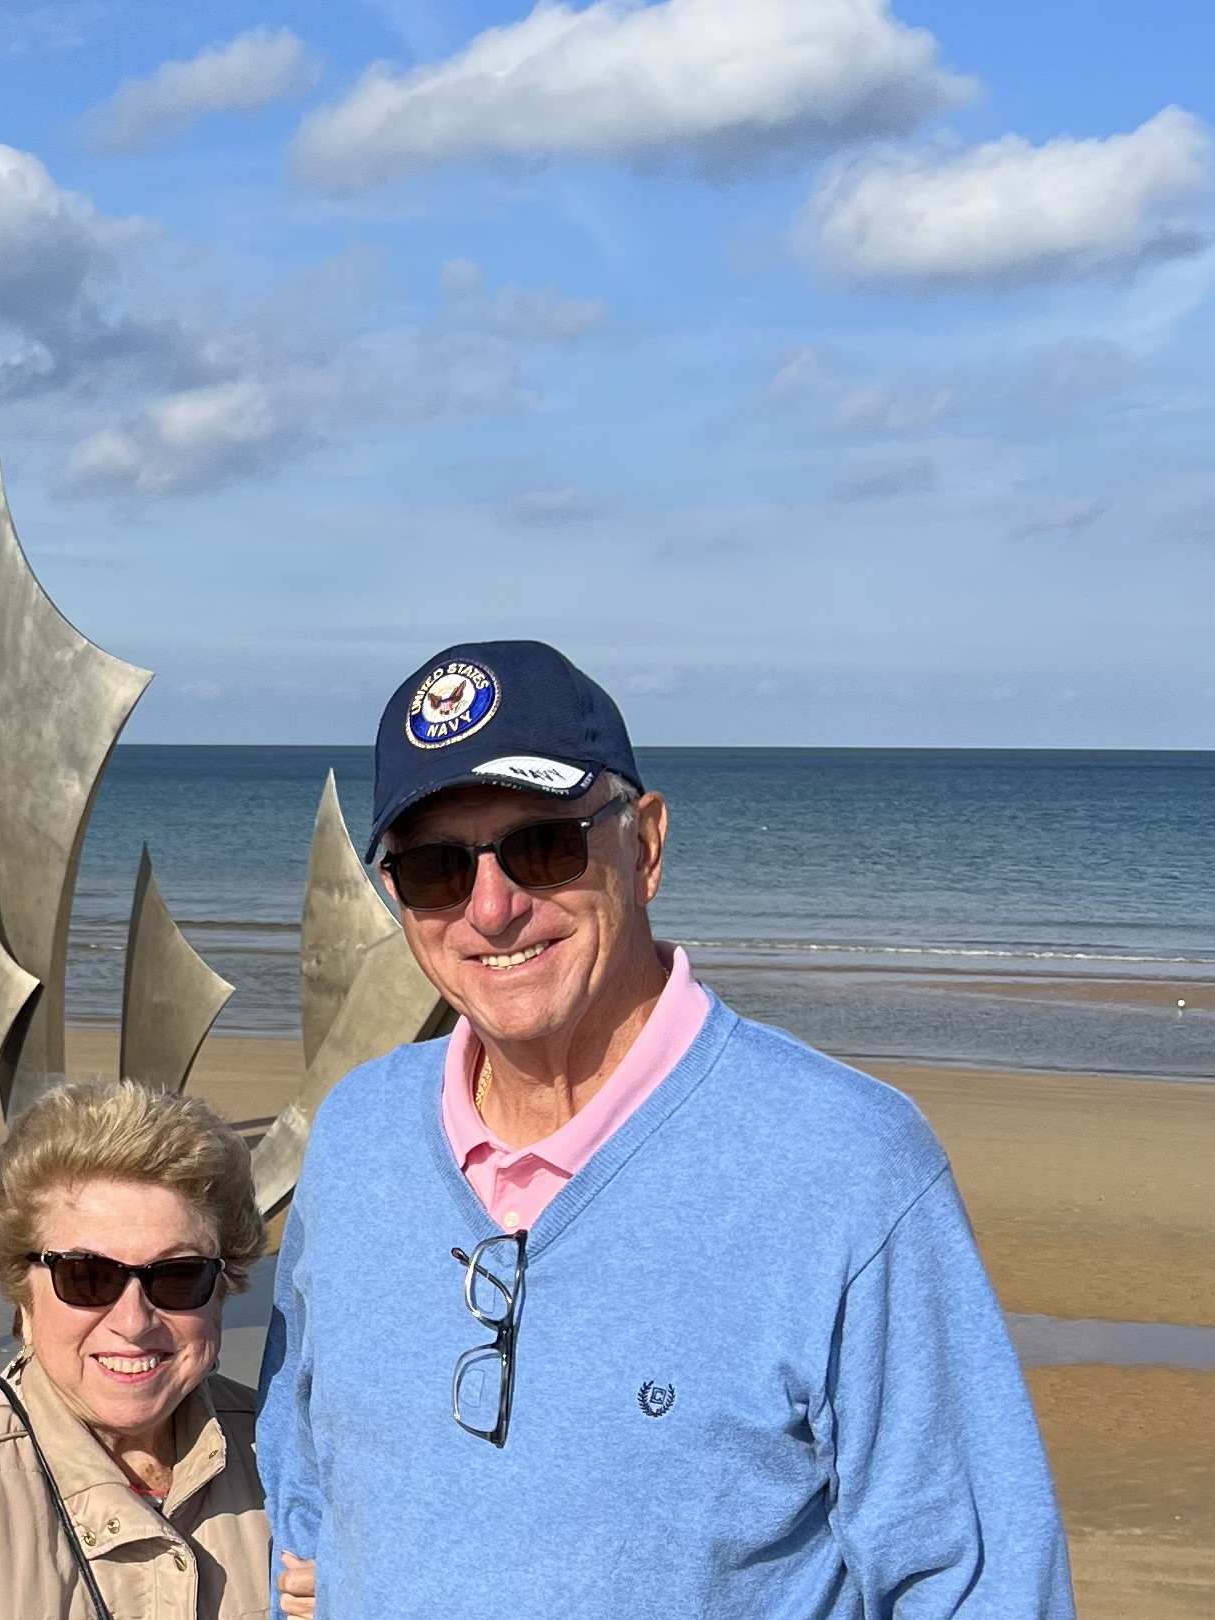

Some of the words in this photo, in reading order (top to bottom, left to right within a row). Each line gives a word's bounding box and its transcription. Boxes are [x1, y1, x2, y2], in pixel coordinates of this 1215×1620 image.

[411, 668, 444, 716] UNITED
[447, 663, 490, 690] STATES
[427, 711, 473, 737] NAVY
